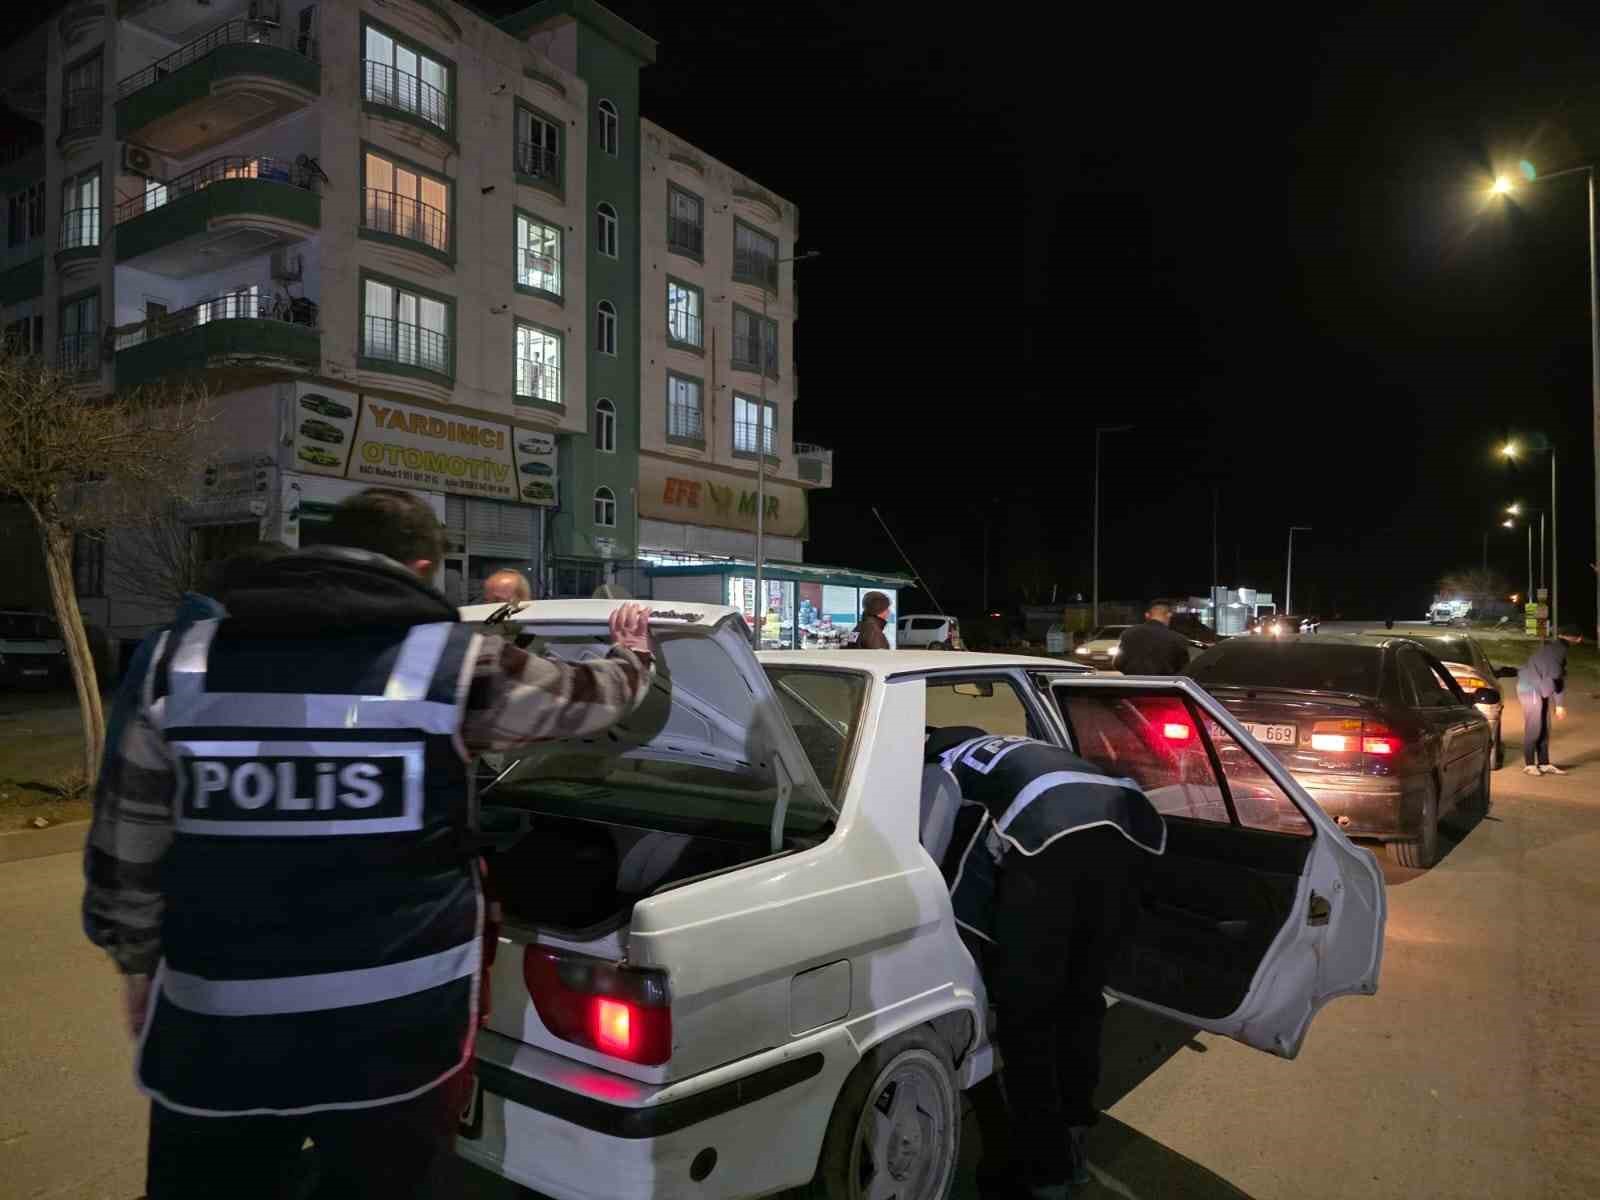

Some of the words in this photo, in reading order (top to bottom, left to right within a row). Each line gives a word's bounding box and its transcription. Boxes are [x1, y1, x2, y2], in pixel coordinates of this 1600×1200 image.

[368, 403, 505, 450] YARDIMCI
[663, 477, 702, 508] EFE
[1266, 726, 1292, 742] 669
